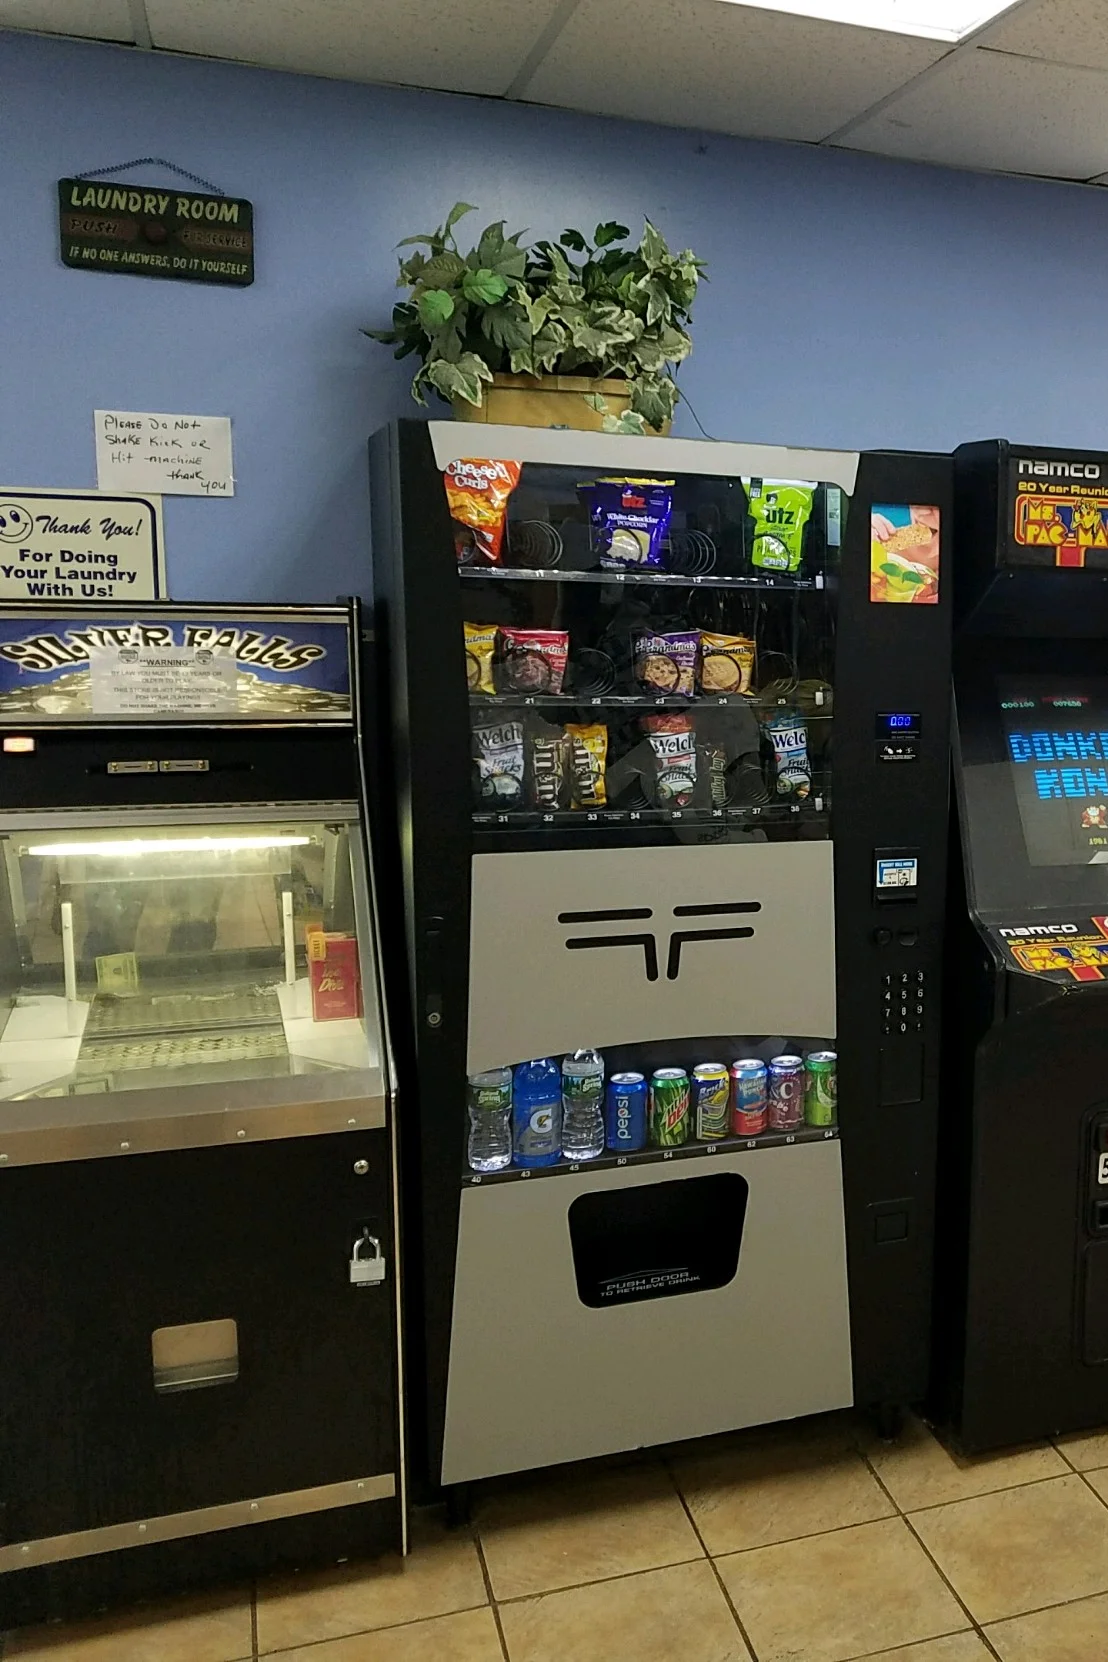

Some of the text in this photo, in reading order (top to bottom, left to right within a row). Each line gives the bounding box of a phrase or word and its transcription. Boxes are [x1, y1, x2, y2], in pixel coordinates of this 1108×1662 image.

[71, 186, 239, 223] LAUNDRY ROOM
[70, 219, 119, 235] PUSH
[206, 232, 248, 248] SERVICE
[69, 246, 248, 275] IF NO ONE ANSWERS, DO IT YOURSELF
[446, 461, 497, 480] Cheese
[1018, 460, 1100, 479] namco
[454, 476, 489, 490] Curls
[1018, 481, 1037, 492] 20
[1038, 482, 1069, 494] Year
[617, 520, 648, 529] POPCORN
[765, 507, 795, 525] utz
[35, 515, 143, 541] Thank You!
[18, 549, 118, 567] For Doing
[0, 565, 137, 584] Your Laundry
[27, 582, 114, 597] With Us!
[1, 624, 325, 670] SILVER FALLS
[999, 924, 1078, 937] namco
[1026, 937, 1056, 945] Year
[1056, 934, 1105, 943] Reunion
[530, 1108, 553, 1134] G
[615, 1095, 631, 1139] pepsi
[606, 1271, 689, 1291] PUSH DOOR
[616, 1282, 665, 1295] RETRIEVE
[668, 1275, 700, 1285] DRINK
